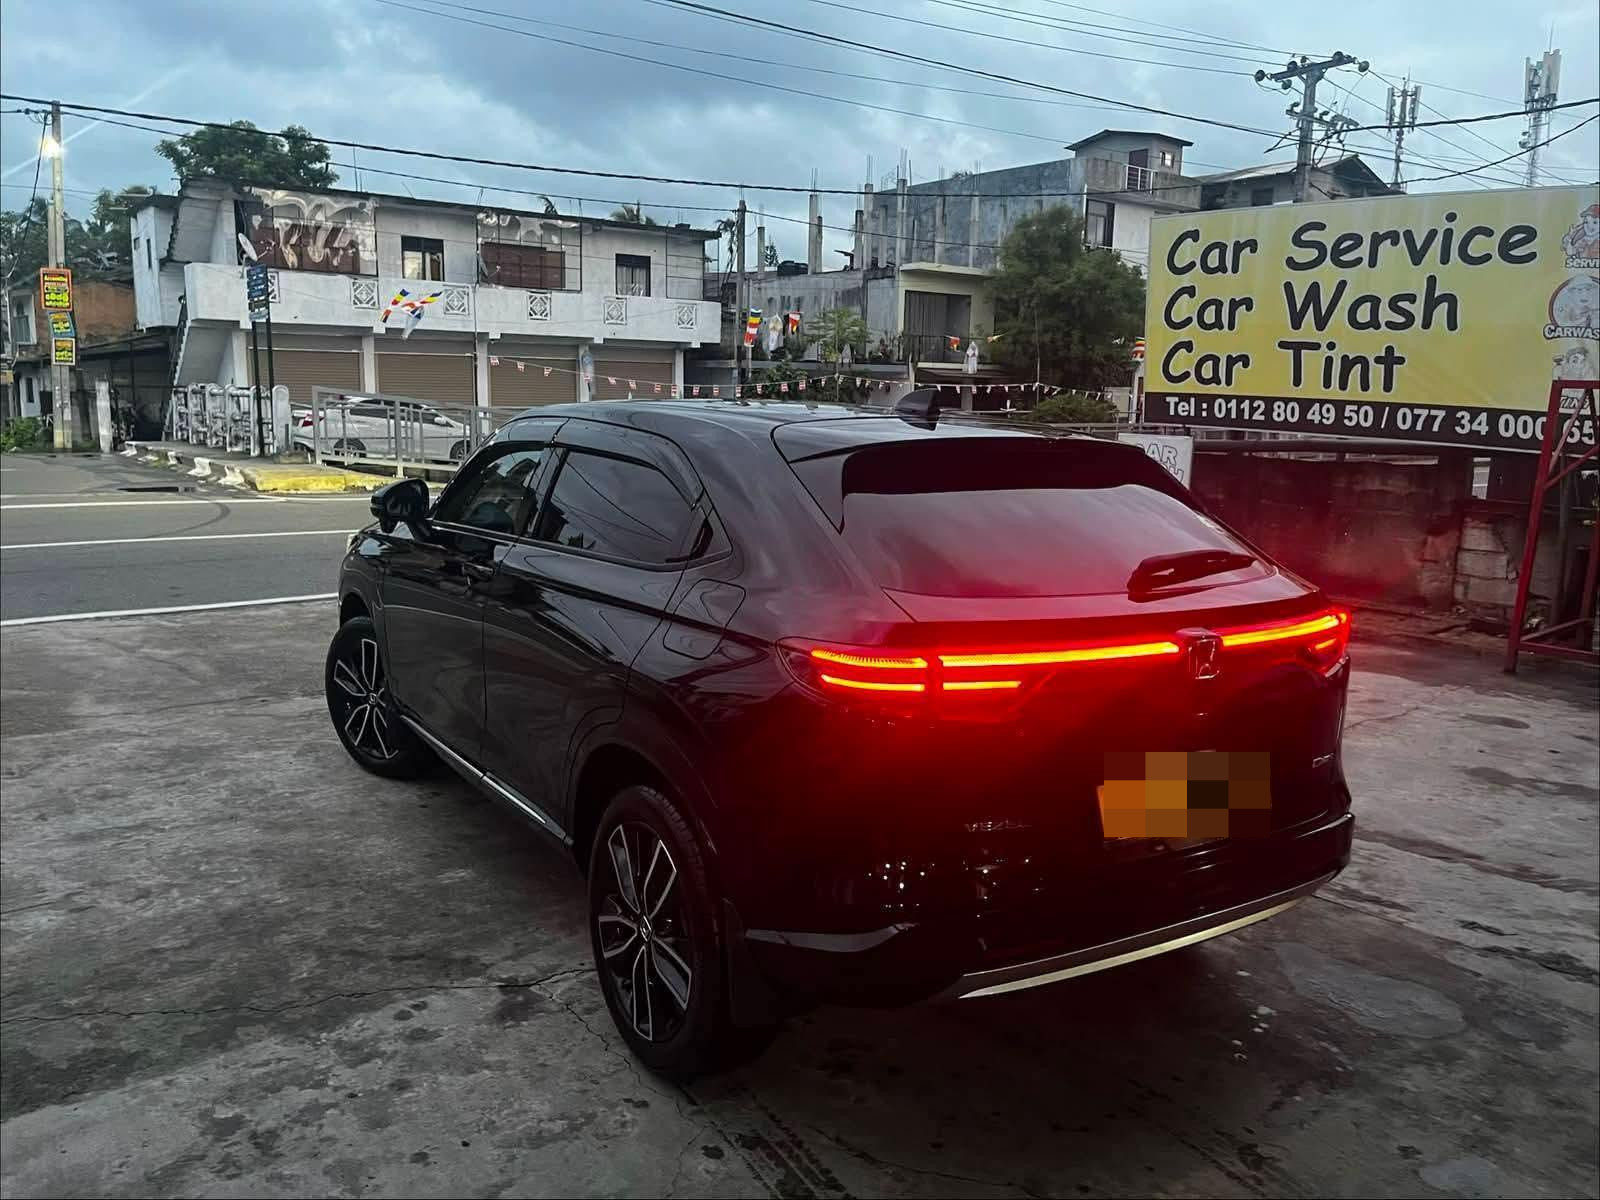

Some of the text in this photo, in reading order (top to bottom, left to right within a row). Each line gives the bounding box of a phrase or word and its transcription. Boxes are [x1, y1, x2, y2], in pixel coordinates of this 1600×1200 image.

[1166, 212, 1539, 275] Car Service
[1163, 275, 1459, 332] Car Wash
[1161, 340, 1406, 393] Car Tint
[1165, 396, 1195, 417] Tel
[1213, 398, 1266, 421] 0112
[1272, 401, 1300, 423] 80
[1306, 402, 1336, 425] 49
[1343, 404, 1374, 428] 50
[1381, 406, 1390, 430] /
[1396, 407, 1446, 432] 077
[1454, 410, 1489, 436] 34
